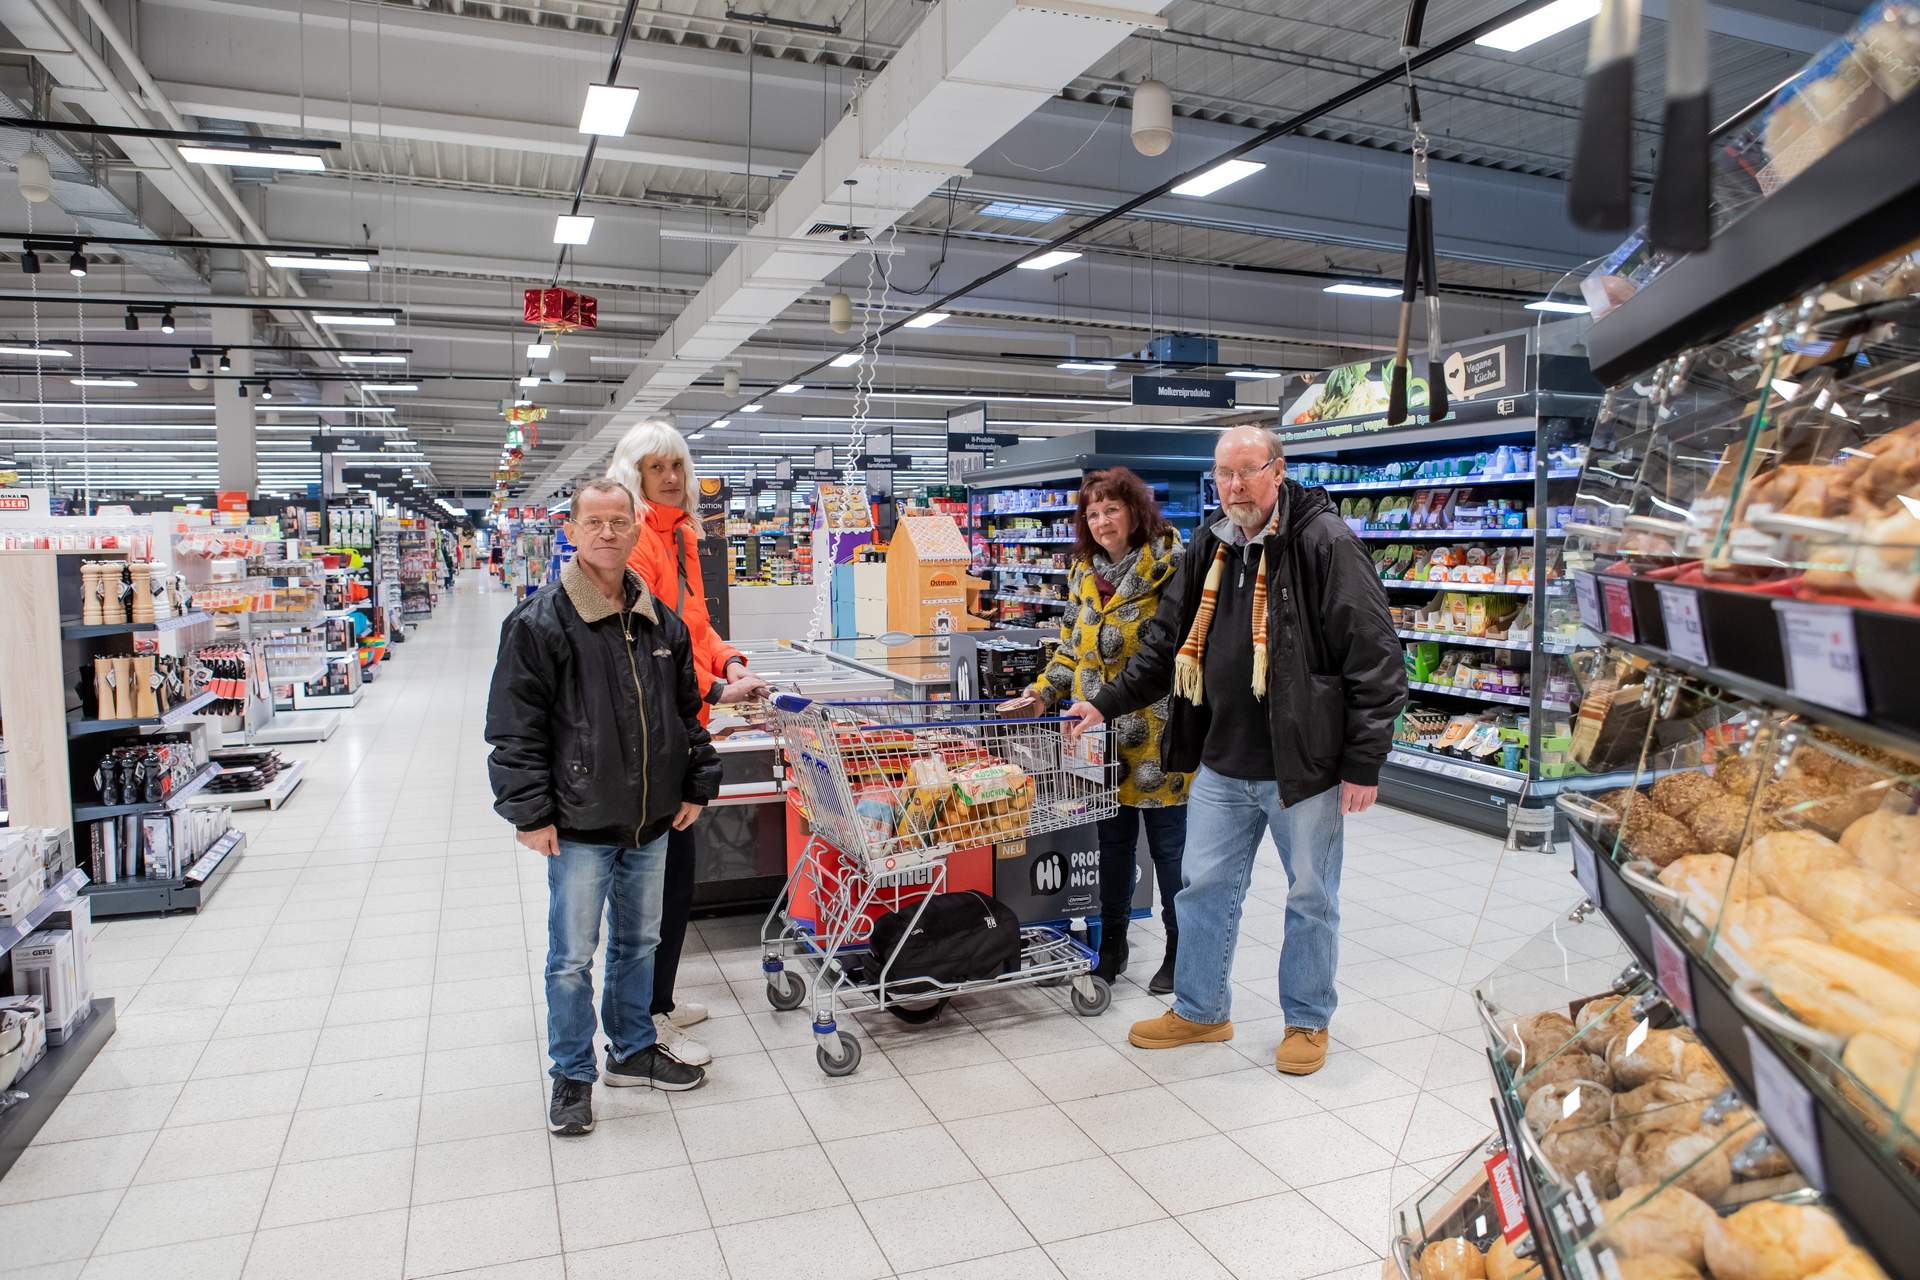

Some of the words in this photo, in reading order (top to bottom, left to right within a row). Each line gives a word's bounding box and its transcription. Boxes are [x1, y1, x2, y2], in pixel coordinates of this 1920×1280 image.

[1466, 358, 1493, 374] Vegane
[1474, 369, 1497, 385] Küche
[1158, 386, 1211, 398] Molkereiprodukte
[1002, 843, 1024, 856] NEU
[1036, 854, 1062, 891] Hi
[32, 949, 53, 957] GEFU
